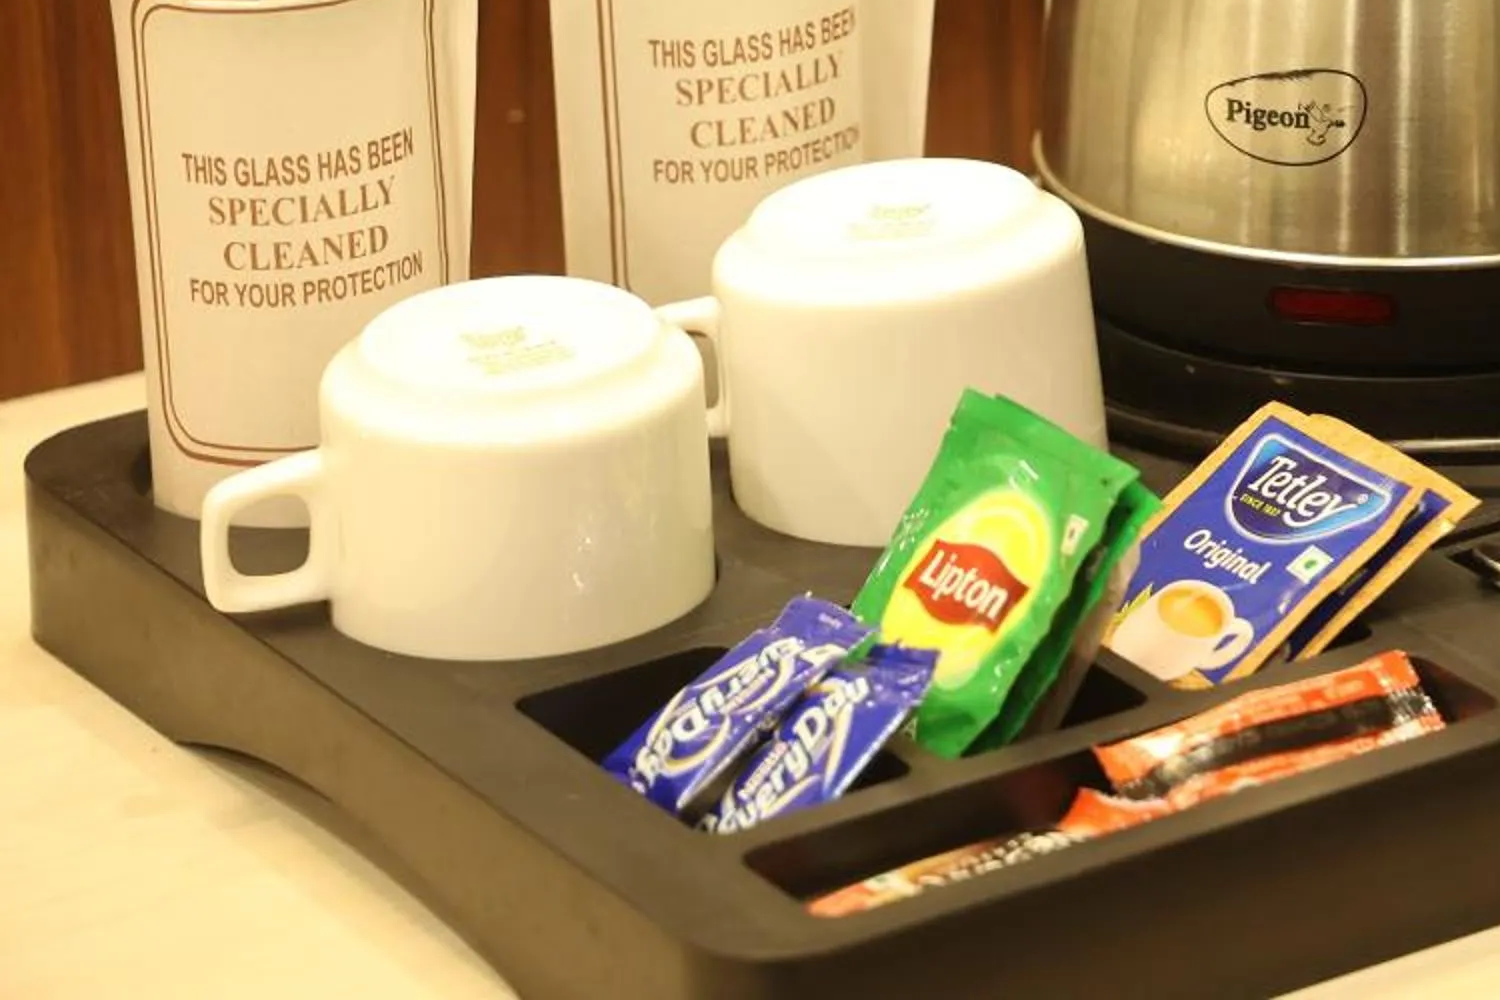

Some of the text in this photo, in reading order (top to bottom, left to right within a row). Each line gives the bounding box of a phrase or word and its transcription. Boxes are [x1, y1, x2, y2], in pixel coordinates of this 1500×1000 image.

[648, 38, 696, 69] THIS
[702, 31, 774, 68] GLASS
[778, 20, 817, 57] HAS
[674, 50, 844, 107] SPECIALLY
[689, 95, 837, 150] CLEANED
[1225, 97, 1311, 132] Pigeon
[181, 126, 414, 188] THIS GLASS HAS BEEN
[652, 158, 695, 184] FOR
[699, 156, 759, 184] YOUR
[207, 174, 397, 228] SPECIALLY
[222, 224, 390, 272] CLEANED
[189, 250, 424, 309] FOR YOUR PROTECTION
[1247, 455, 1358, 528] Tetley
[918, 549, 1009, 620] Lipton
[1182, 528, 1272, 585] Original
